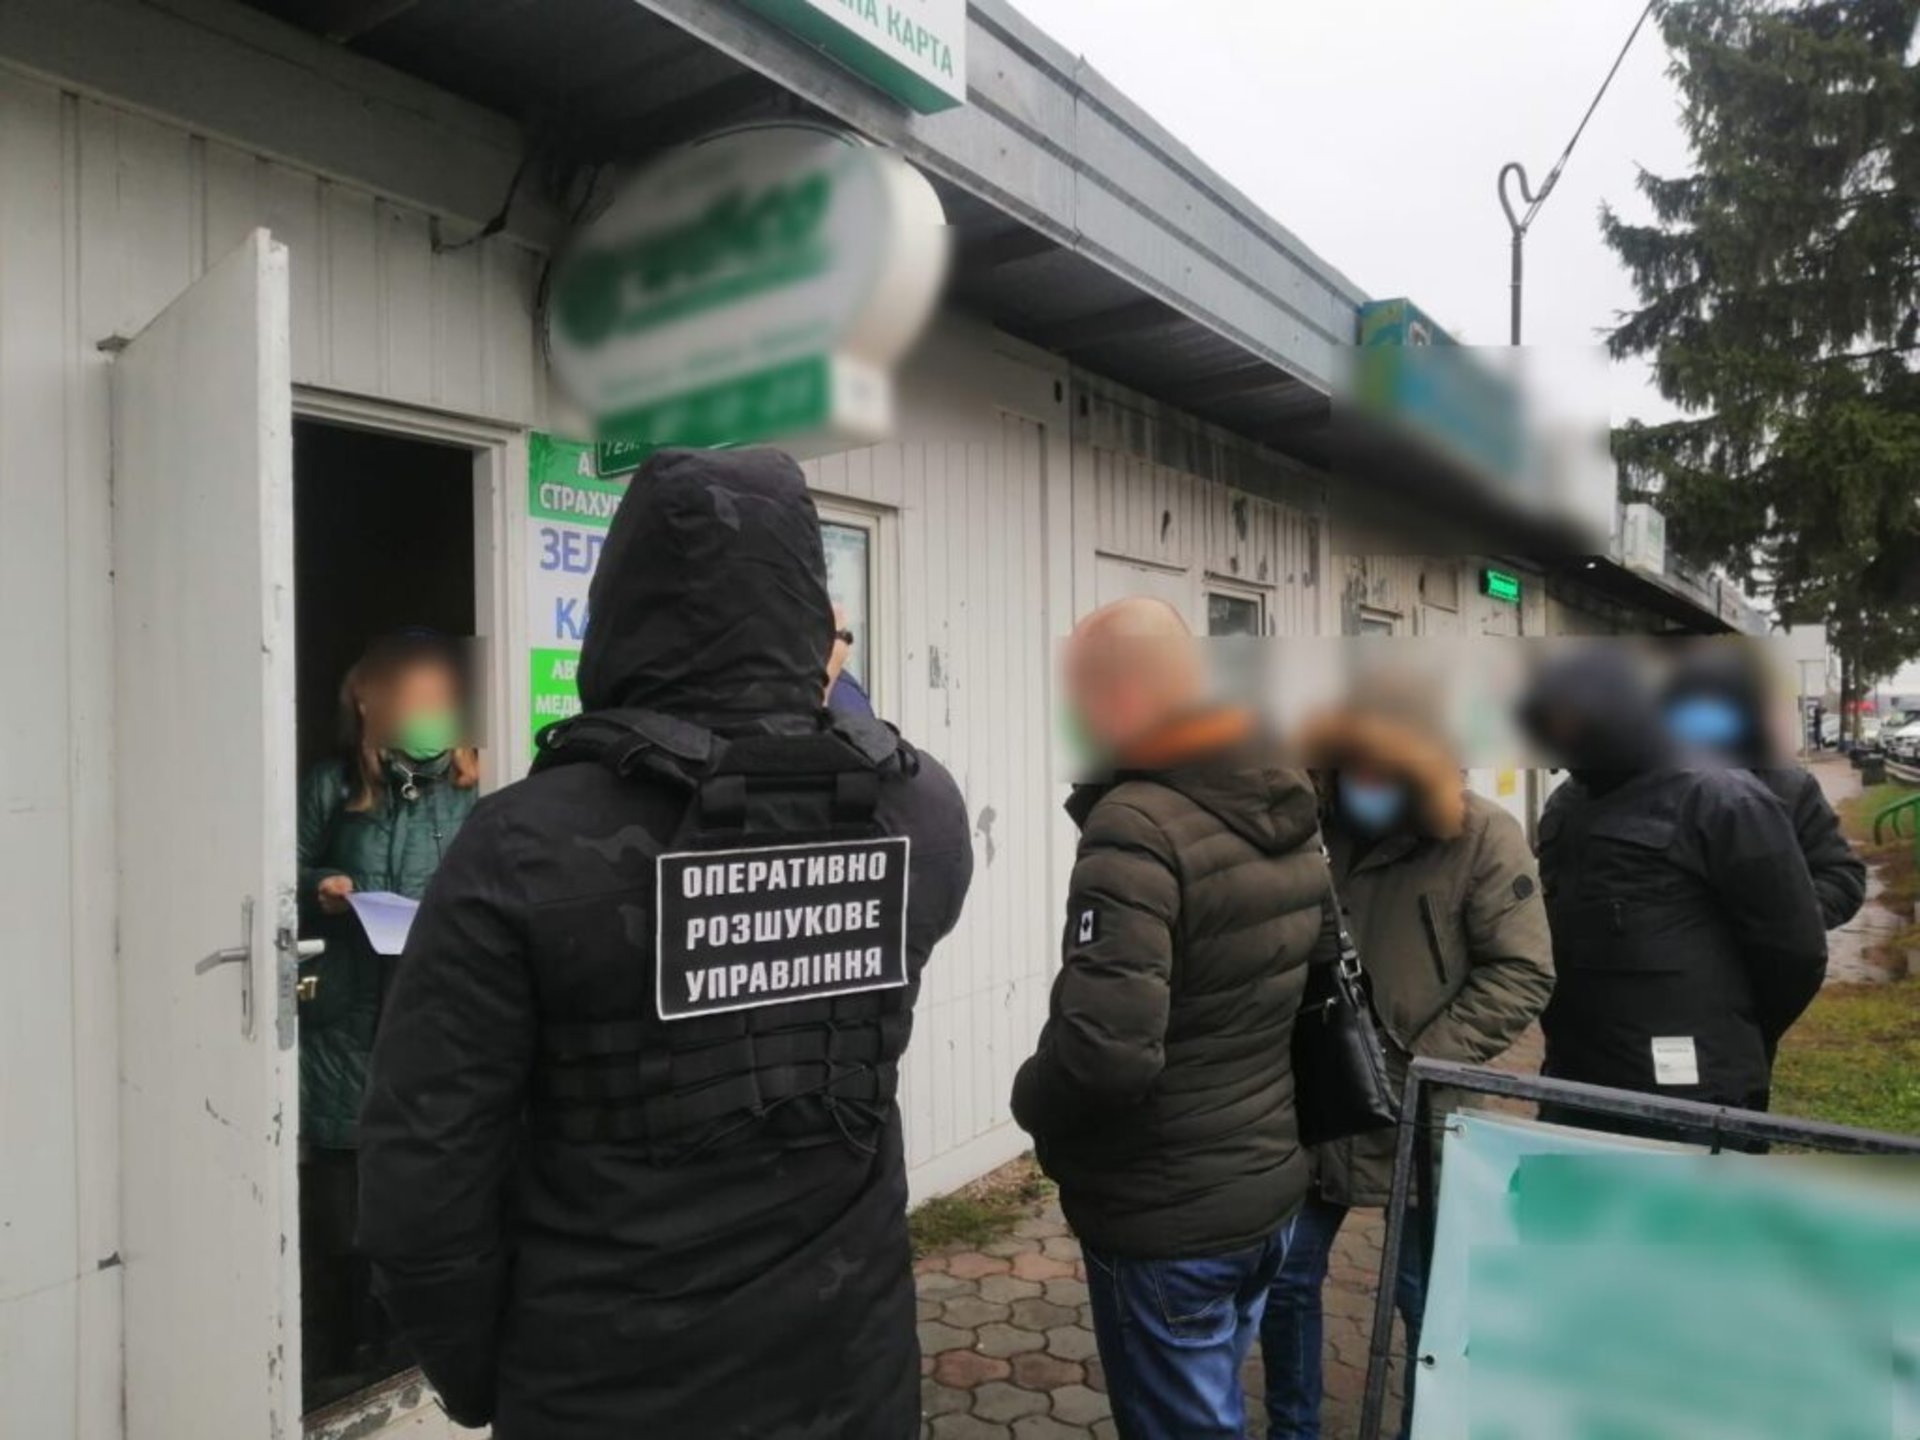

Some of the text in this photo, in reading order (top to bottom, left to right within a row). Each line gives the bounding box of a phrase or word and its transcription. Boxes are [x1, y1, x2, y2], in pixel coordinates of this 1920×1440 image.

[886, 4, 954, 79] КАРТА
[682, 851, 888, 899] ОПЕРАТИВНО
[686, 899, 882, 950] РОЗШУКОВЕ
[685, 946, 882, 1003] УПРАВЛІННЯ
